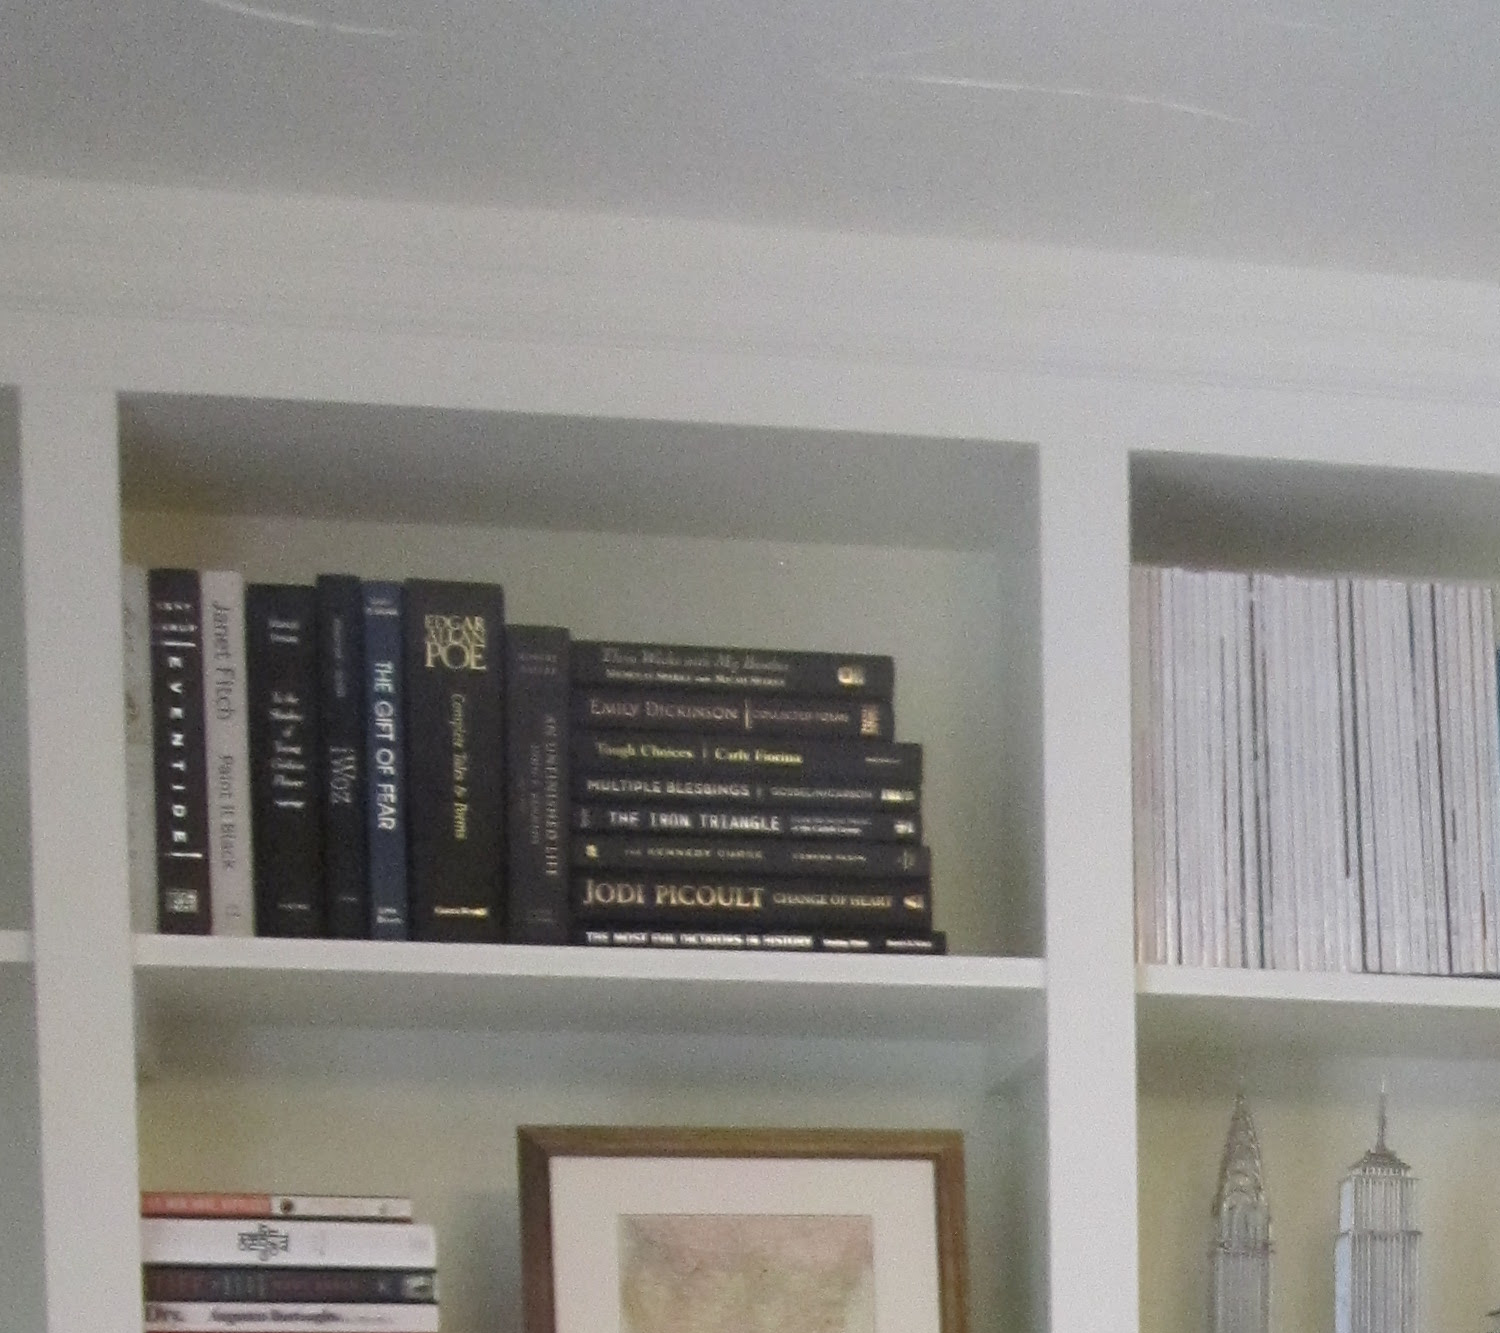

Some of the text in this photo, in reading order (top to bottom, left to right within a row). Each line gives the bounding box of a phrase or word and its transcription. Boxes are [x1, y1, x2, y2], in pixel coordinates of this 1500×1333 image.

[425, 643, 487, 671] POE
[215, 667, 235, 720] Fitch
[590, 699, 738, 720] EMILY DICKINSON
[168, 655, 187, 843] EVENTIDE
[374, 660, 398, 831] THE GIFT OF FEAR
[586, 779, 750, 798] MULTIPLE BLESSINGS
[609, 811, 640, 827] THE
[700, 814, 781, 832] TRIANGLE
[583, 878, 766, 909] JODI PICOULT
